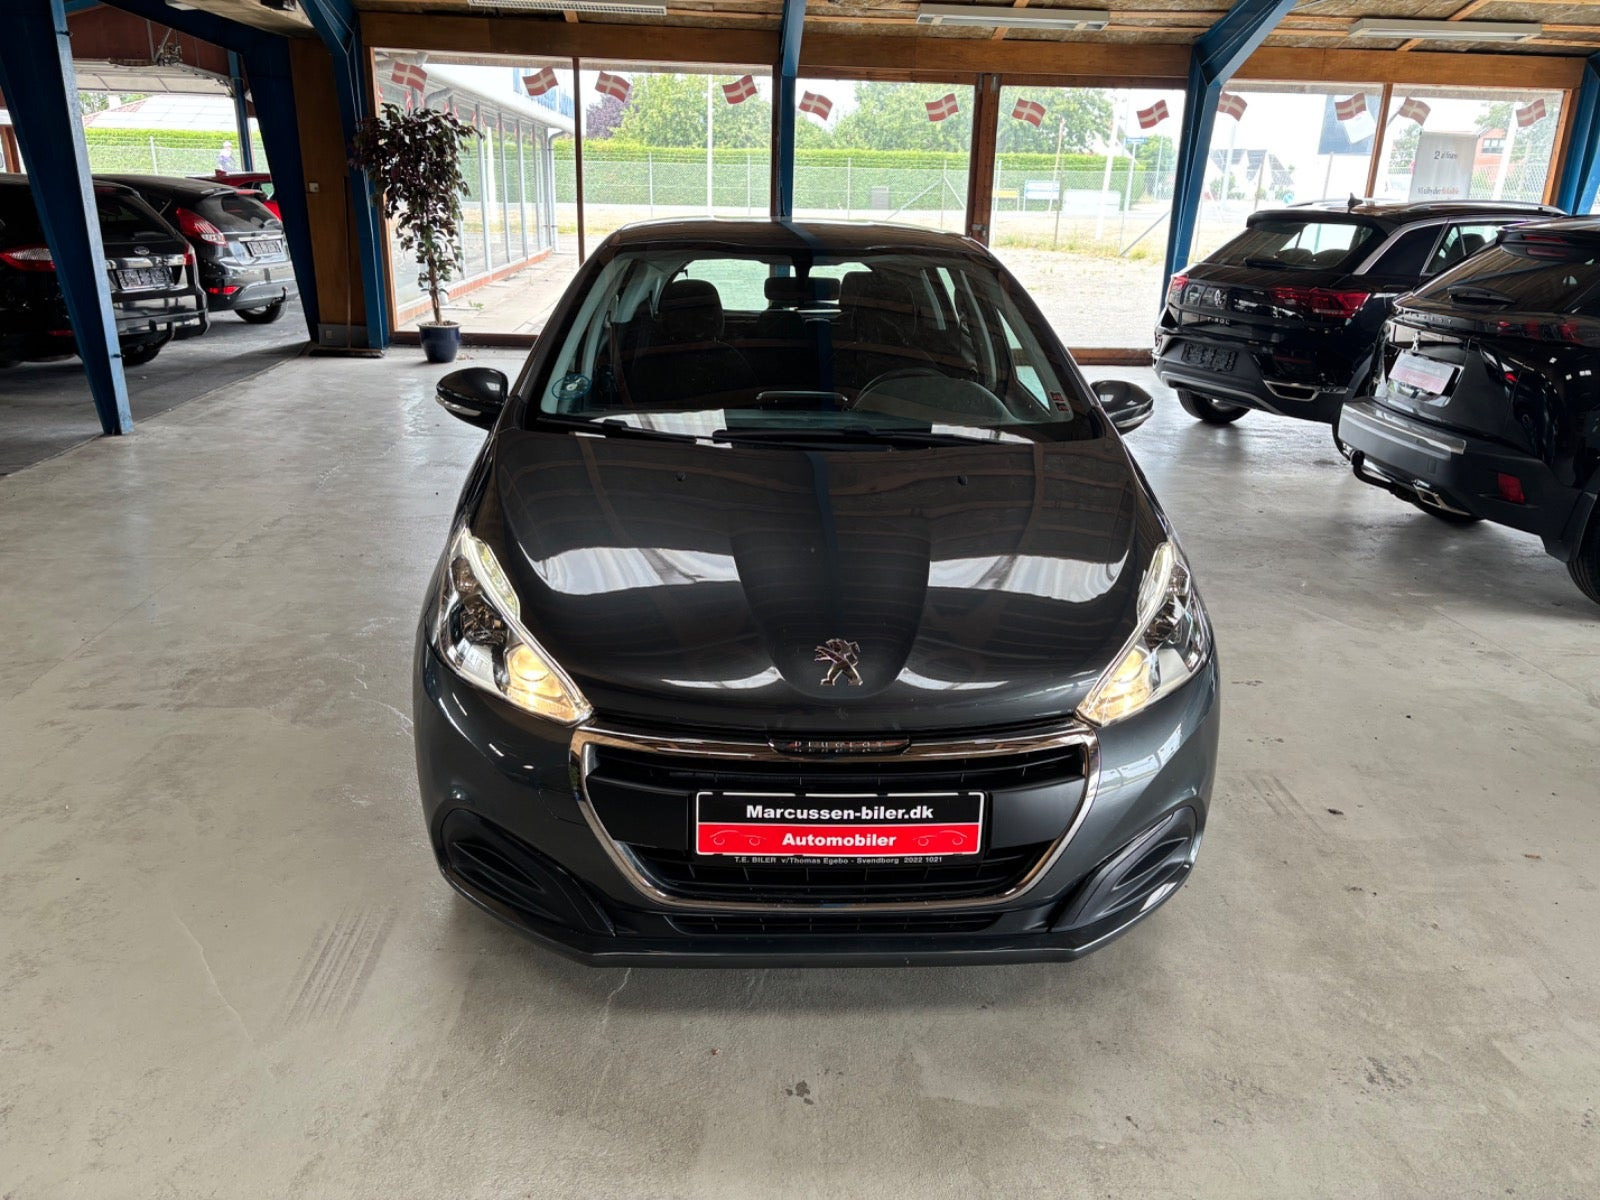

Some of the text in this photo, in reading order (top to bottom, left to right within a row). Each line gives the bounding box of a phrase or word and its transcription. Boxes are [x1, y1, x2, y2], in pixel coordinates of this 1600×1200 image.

[745, 804, 934, 820] Marcussen-biler.dk
[782, 833, 897, 847] Automobiler
[734, 856, 750, 864] T.E.
[751, 856, 777, 864] BILER
[856, 856, 900, 865] Svendborg
